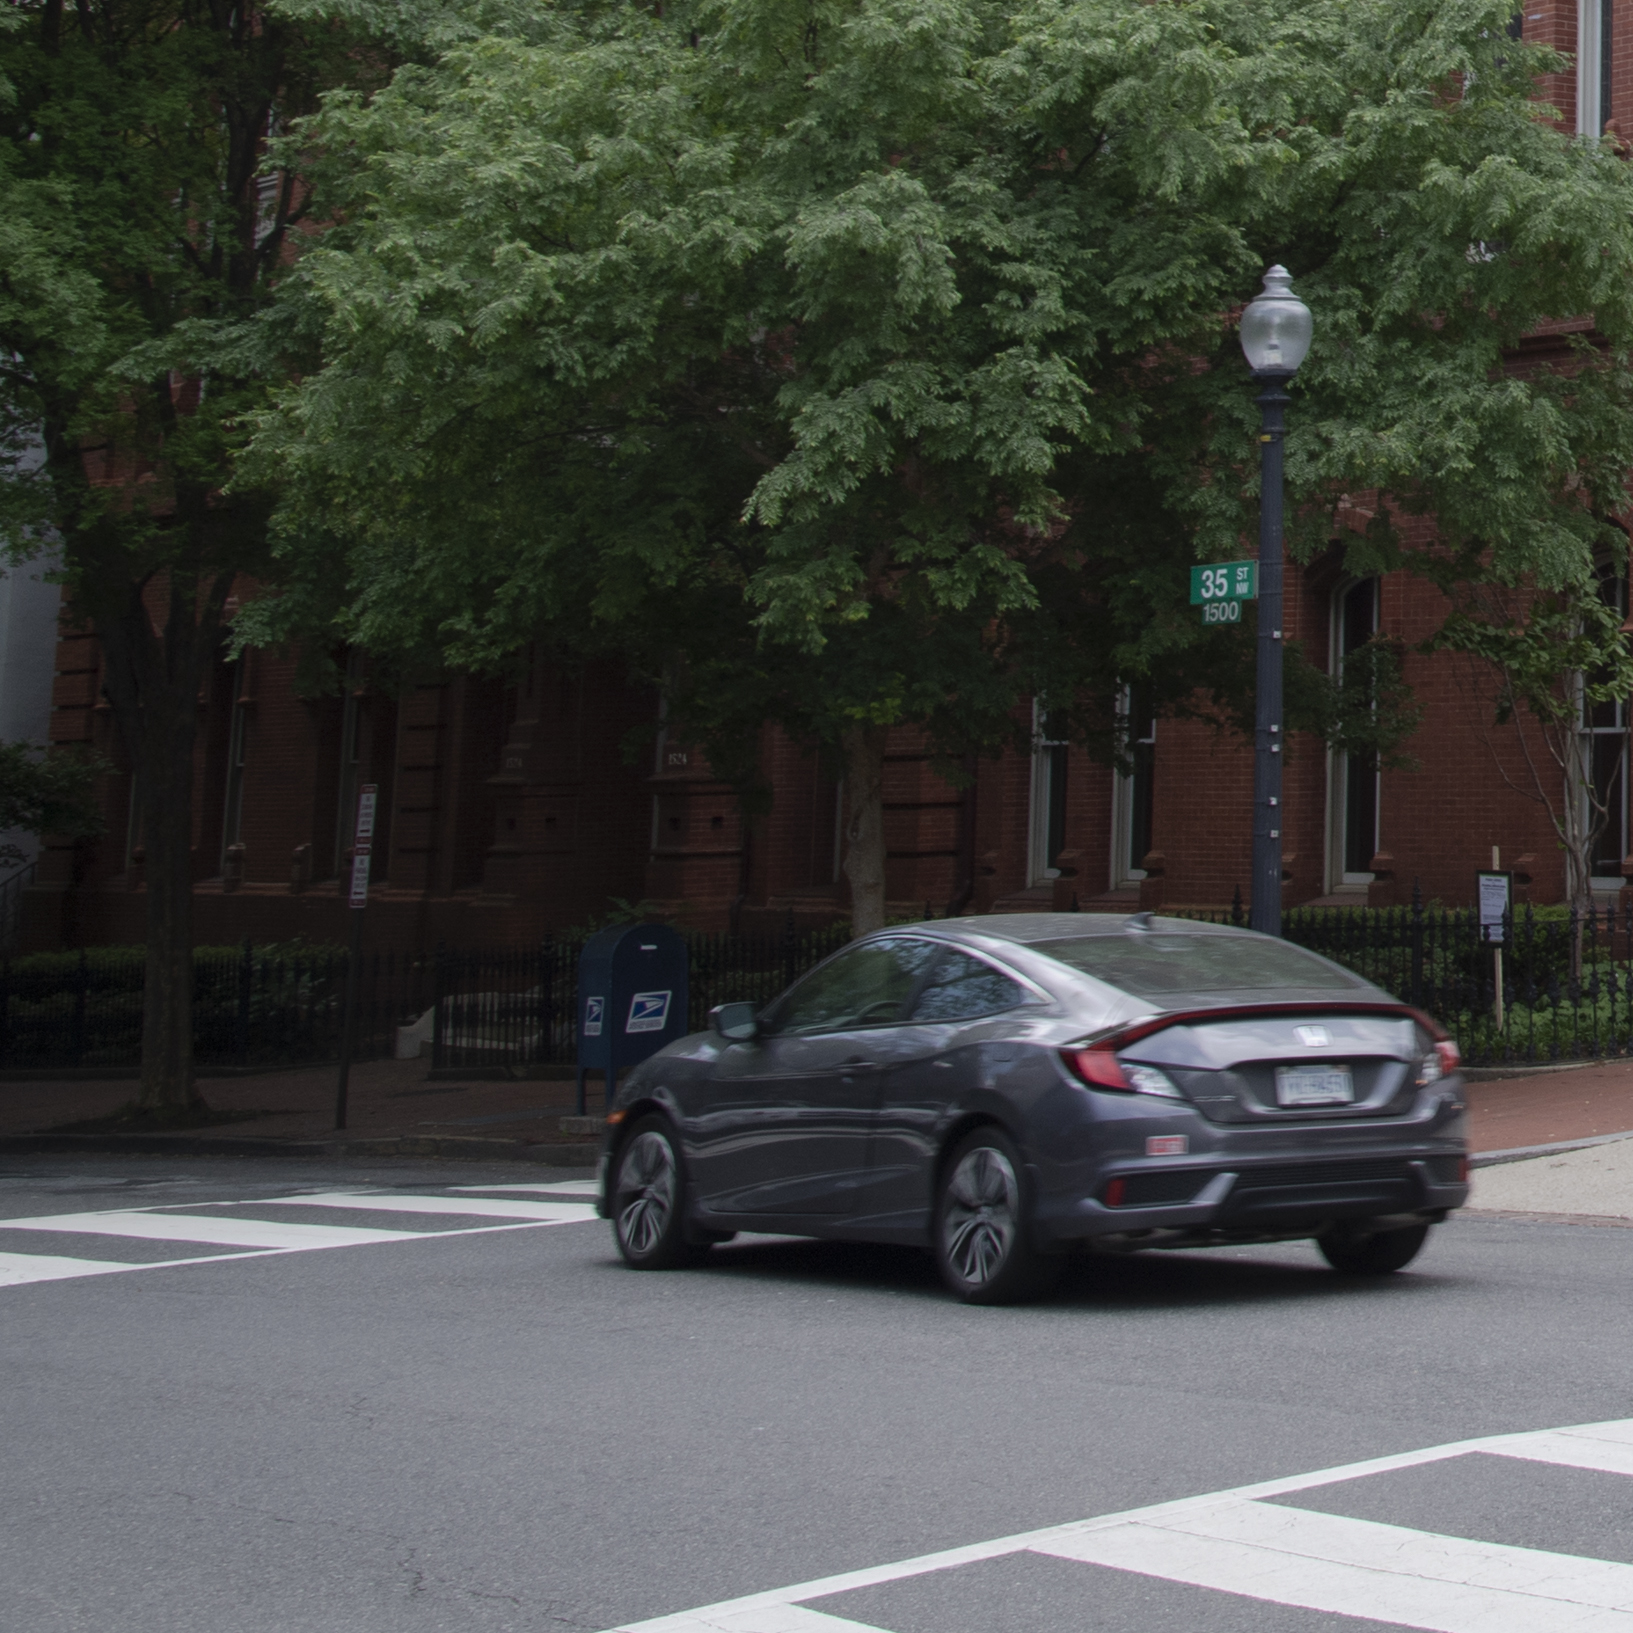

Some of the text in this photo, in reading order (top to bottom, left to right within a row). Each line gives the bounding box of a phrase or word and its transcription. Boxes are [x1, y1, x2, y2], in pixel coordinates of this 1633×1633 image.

[1201, 567, 1249, 598] 35 ST
[1236, 582, 1249, 595] NW
[1203, 601, 1239, 622] 1500
